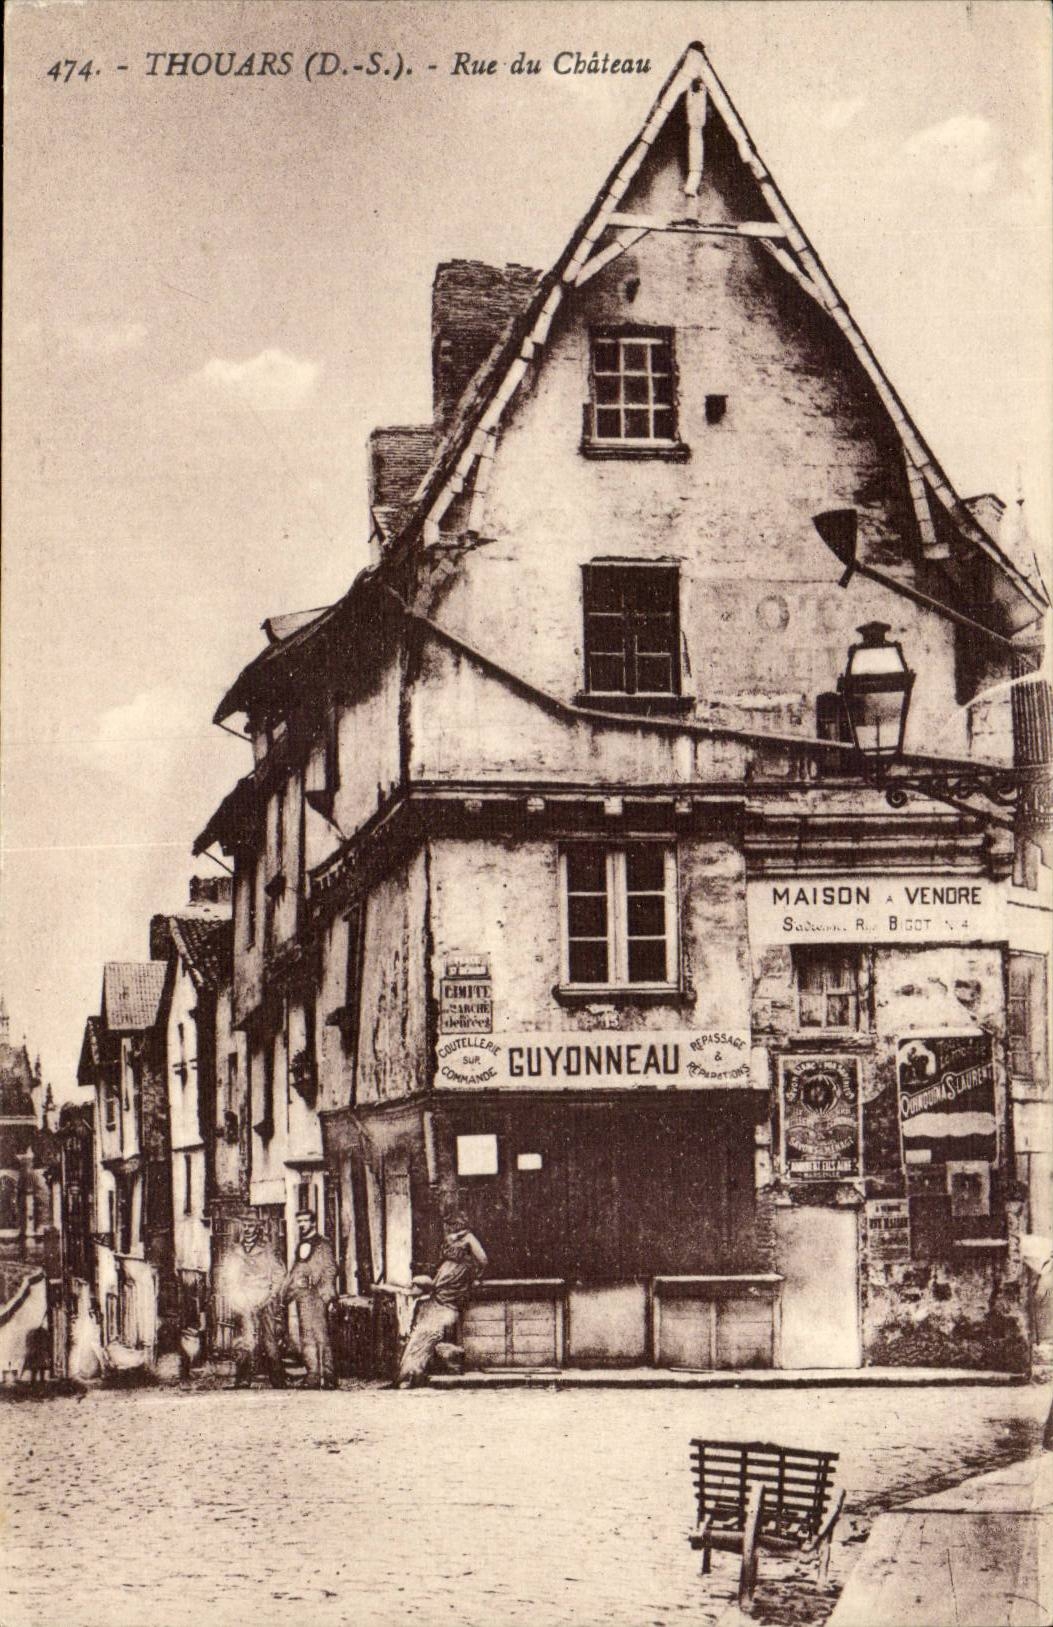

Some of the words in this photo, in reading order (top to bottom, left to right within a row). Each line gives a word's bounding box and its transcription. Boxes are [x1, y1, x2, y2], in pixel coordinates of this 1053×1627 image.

[773, 887, 870, 905] MAISON
[905, 887, 982, 905] VENDRE
[438, 1037, 501, 1058] COUTELLERIE
[690, 1033, 746, 1051] REPASSAGE
[509, 1044, 679, 1077] GUYONNEAU
[714, 1050, 722, 1061] &
[441, 1066, 498, 1084] COMMANDE
